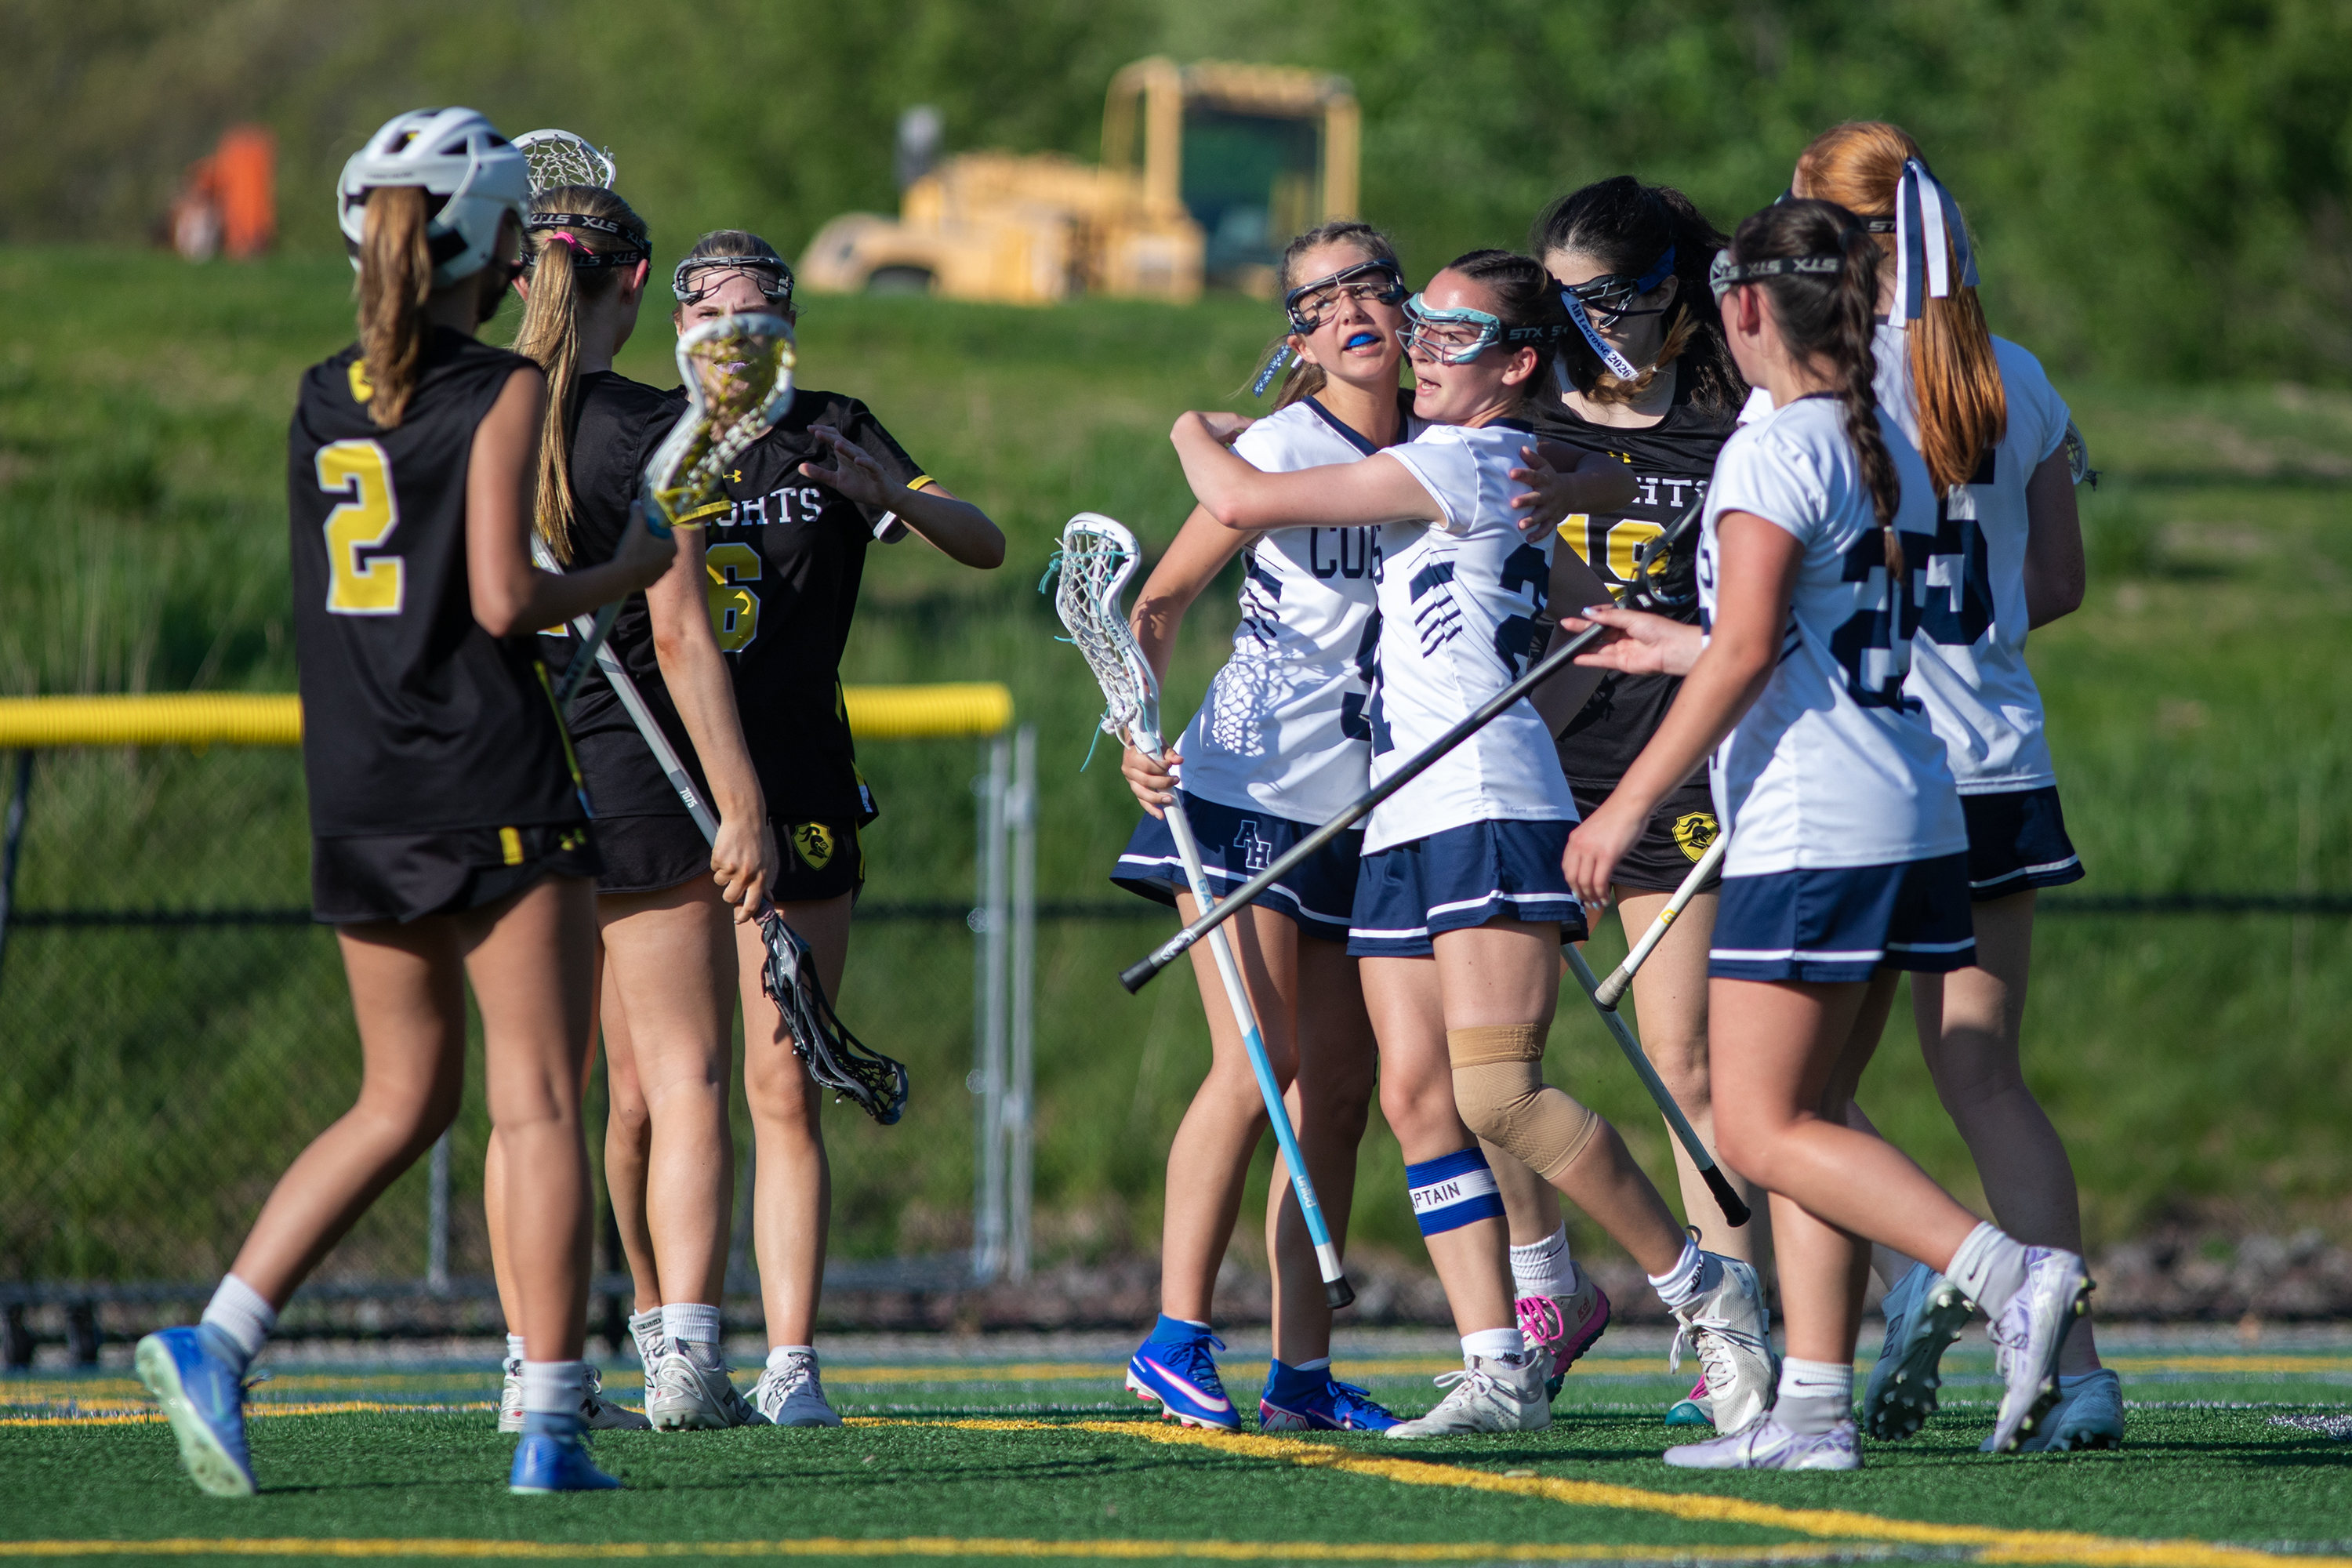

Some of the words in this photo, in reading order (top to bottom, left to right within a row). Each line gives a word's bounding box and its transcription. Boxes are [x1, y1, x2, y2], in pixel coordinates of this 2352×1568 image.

[582, 216, 619, 234] STX
[1867, 220, 1896, 232] ST
[574, 256, 601, 267] ST
[612, 252, 637, 265] STX
[1792, 257, 1839, 273] STX
[1508, 327, 1543, 340] STX
[1579, 318, 1610, 356] Lacrosse
[1607, 354, 1632, 378] 2026
[314, 438, 406, 615] 2
[706, 543, 762, 653] 6
[679, 786, 698, 808] 7075
